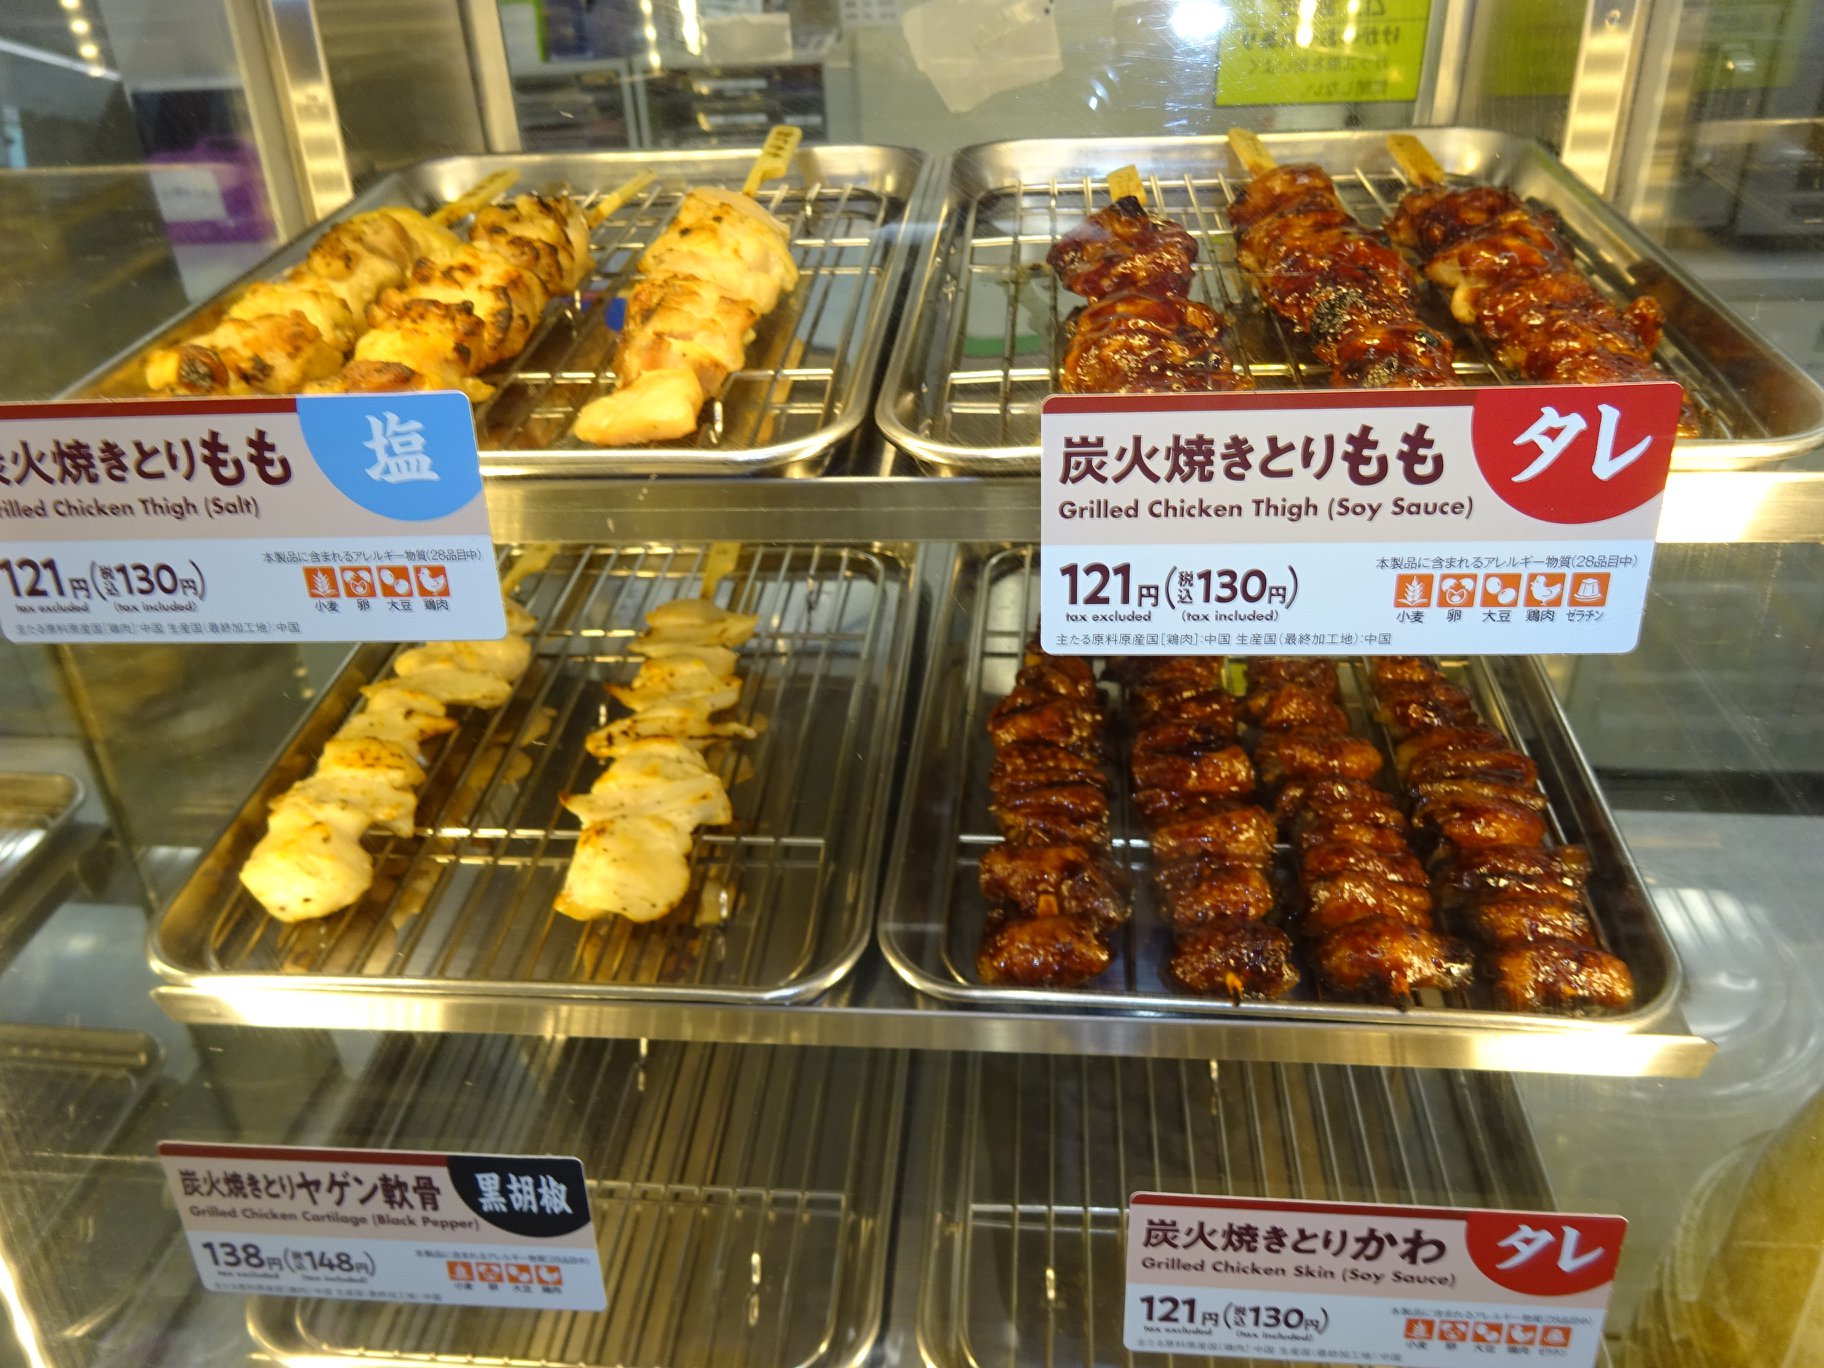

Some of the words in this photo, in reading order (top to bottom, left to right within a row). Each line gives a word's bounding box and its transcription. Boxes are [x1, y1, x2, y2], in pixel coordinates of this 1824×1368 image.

[362, 411, 440, 484] 塩
[1511, 403, 1653, 484] タレ
[0, 427, 292, 486] 火焼きとりもも
[1058, 422, 1445, 487] 炭火焼きとりもも
[53, 496, 134, 517] Chicken
[138, 495, 198, 520] Thigh
[204, 495, 260, 519] (Salt)
[1058, 498, 1139, 520] Grilled
[1147, 497, 1243, 519] Chicken
[1252, 496, 1319, 522] Thigh
[1327, 496, 1383, 523] (Soy
[1391, 496, 1474, 520] Sauce)
[262, 549, 482, 564] 本製品に含まれるアレルギー物質(28品目中)
[1376, 554, 1639, 570] 本製品に含まれるアレルギー物質(28品目中)
[16, 602, 35, 612] tax
[38, 601, 90, 612] excluded
[113, 601, 139, 613] (tax
[142, 601, 197, 613] included)
[315, 600, 339, 612] 小麦
[356, 599, 370, 611] 卵
[388, 600, 413, 612] 大豆
[424, 599, 449, 611] 鶏肉
[1066, 611, 1087, 622] tax
[1092, 610, 1151, 622] excluded
[1181, 610, 1209, 623] (tax
[1214, 610, 1280, 623] included)
[1396, 611, 1425, 623] 小麦
[1446, 610, 1462, 622] 卵
[1482, 611, 1511, 623] 大豆
[1525, 610, 1555, 623] 鶏肉
[1566, 610, 1604, 622] ゼラチン
[179, 1168, 441, 1212] 炭火焼きとりヤゲン軟骨
[474, 1171, 574, 1215] 黒胡椒
[189, 1204, 237, 1219] Grilled
[242, 1207, 298, 1221] Chicken
[302, 1209, 368, 1226] Cartilage
[373, 1212, 416, 1228] (Black
[421, 1214, 480, 1232] Pepper)
[1142, 1218, 1447, 1266] 炭火焼きとりかわ
[1495, 1223, 1605, 1274] タレ
[1141, 1257, 1205, 1273] Grilled
[1211, 1259, 1286, 1278] Chicken
[1292, 1262, 1335, 1279] Skin
[1341, 1265, 1382, 1285] (Soy
[1391, 1269, 1456, 1287] Sauce)
